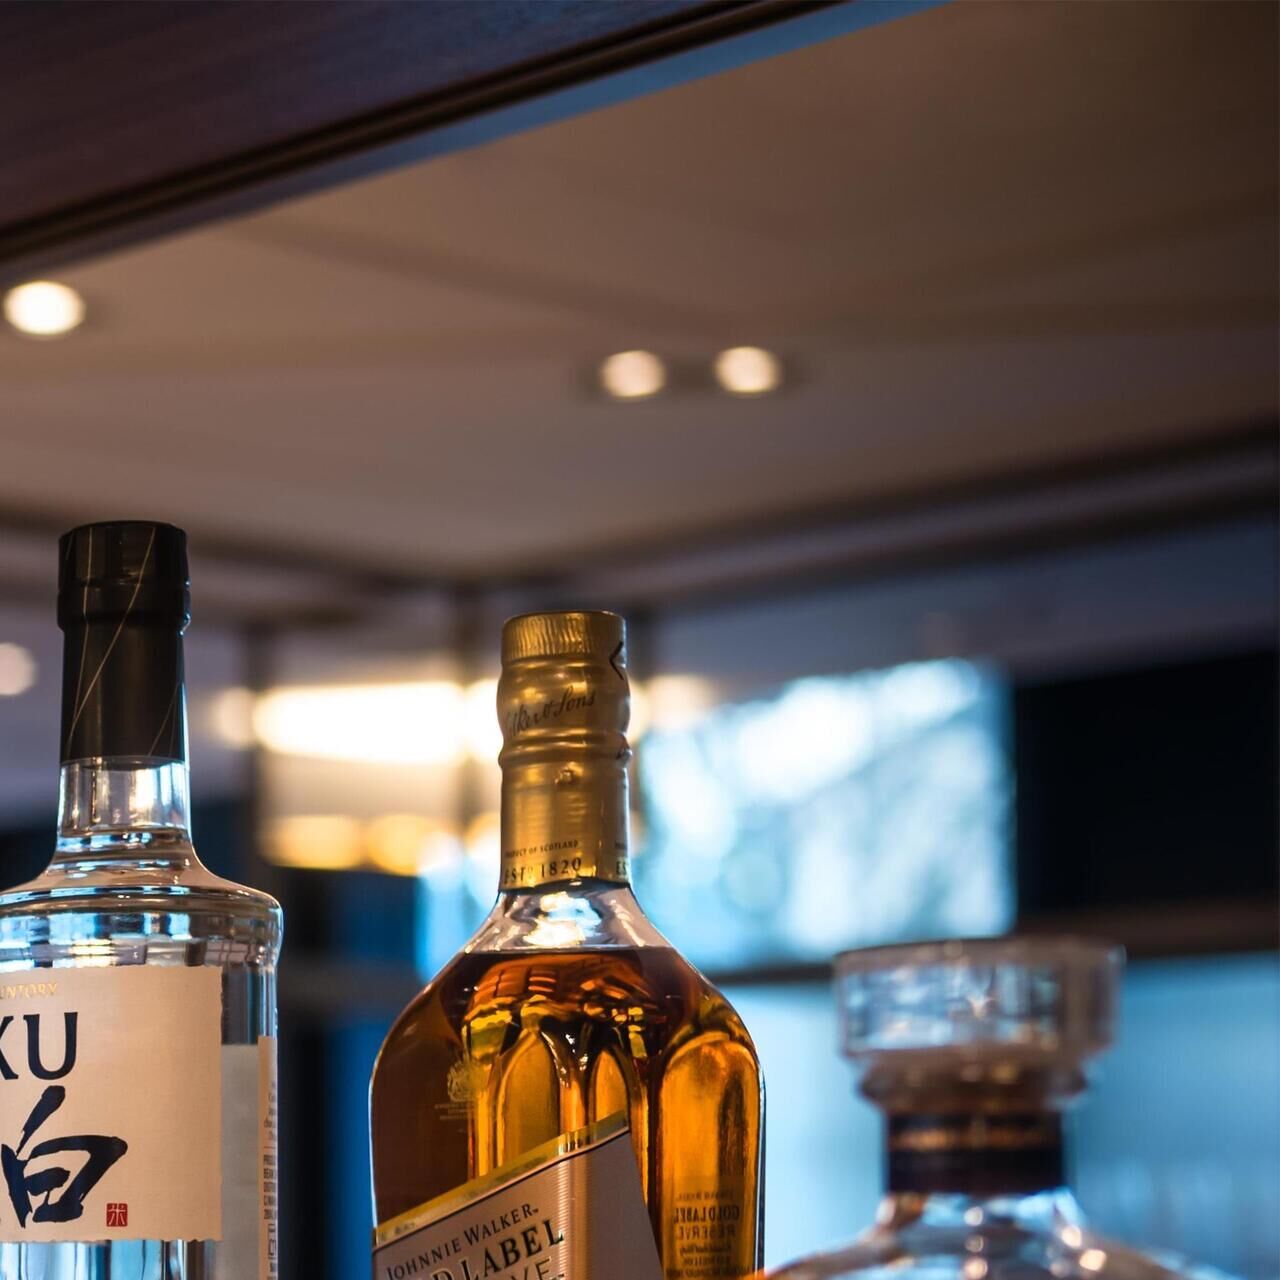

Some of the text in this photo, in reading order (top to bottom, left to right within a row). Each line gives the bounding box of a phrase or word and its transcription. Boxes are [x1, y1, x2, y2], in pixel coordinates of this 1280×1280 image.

[540, 839, 579, 852] SCOTLAND
[541, 857, 582, 878] 1820
[1, 1085, 129, 1229] 白
[462, 1202, 535, 1247] WALKER
